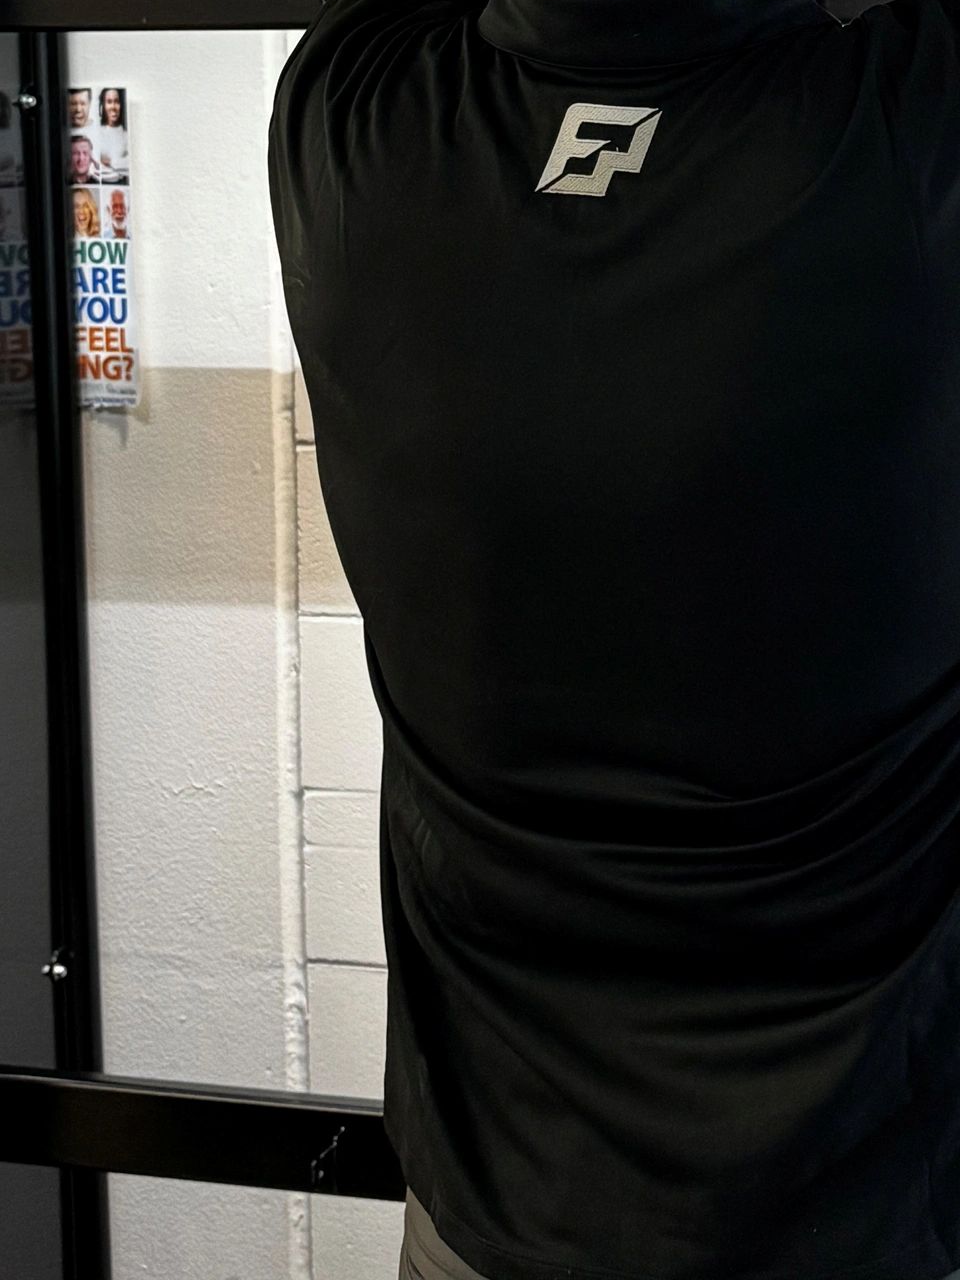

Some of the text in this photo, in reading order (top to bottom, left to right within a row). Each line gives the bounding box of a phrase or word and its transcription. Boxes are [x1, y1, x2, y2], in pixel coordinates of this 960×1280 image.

[72, 241, 128, 265] HOW
[73, 267, 127, 294] ARE
[72, 297, 128, 324] YOU
[75, 326, 134, 353] FEEL
